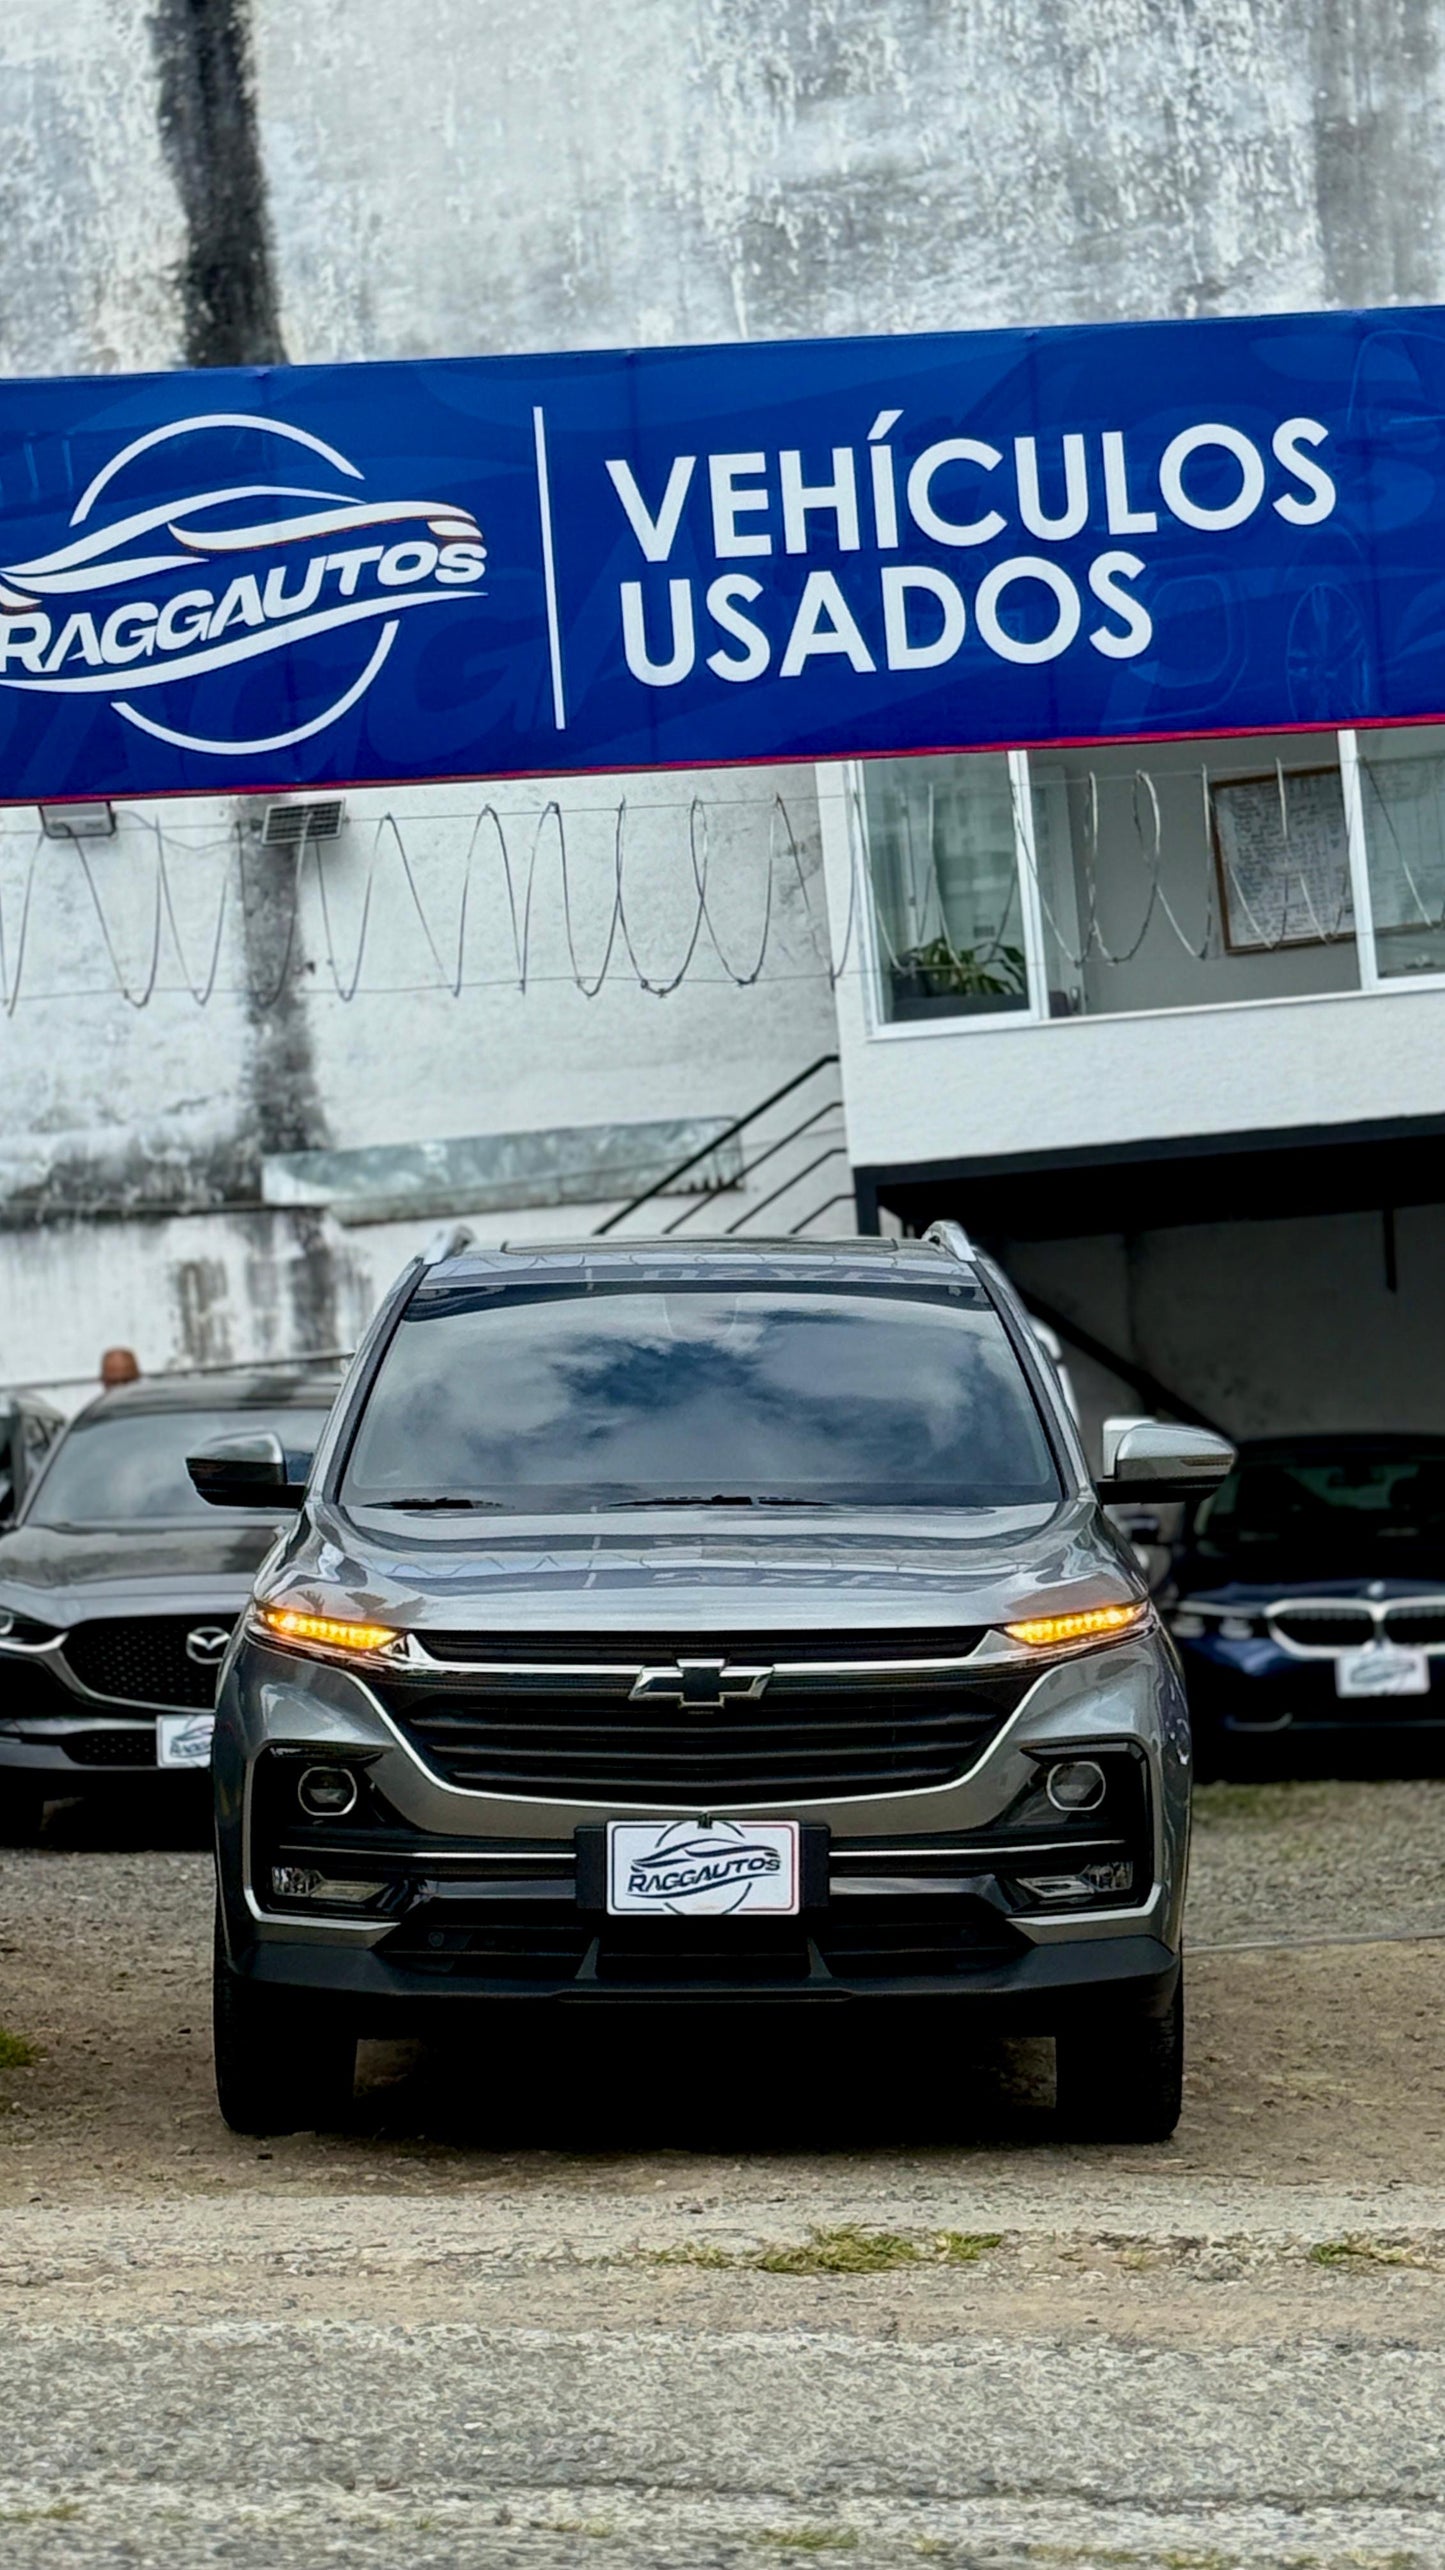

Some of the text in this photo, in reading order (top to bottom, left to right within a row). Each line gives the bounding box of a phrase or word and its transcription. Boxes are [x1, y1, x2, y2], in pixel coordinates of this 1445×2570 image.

[606, 409, 1337, 562] VEHÍCULOS
[0, 541, 488, 673] RAGGAUTOS
[620, 551, 1154, 687] USADOS
[627, 1858, 782, 1893] RAGGAUTOS
